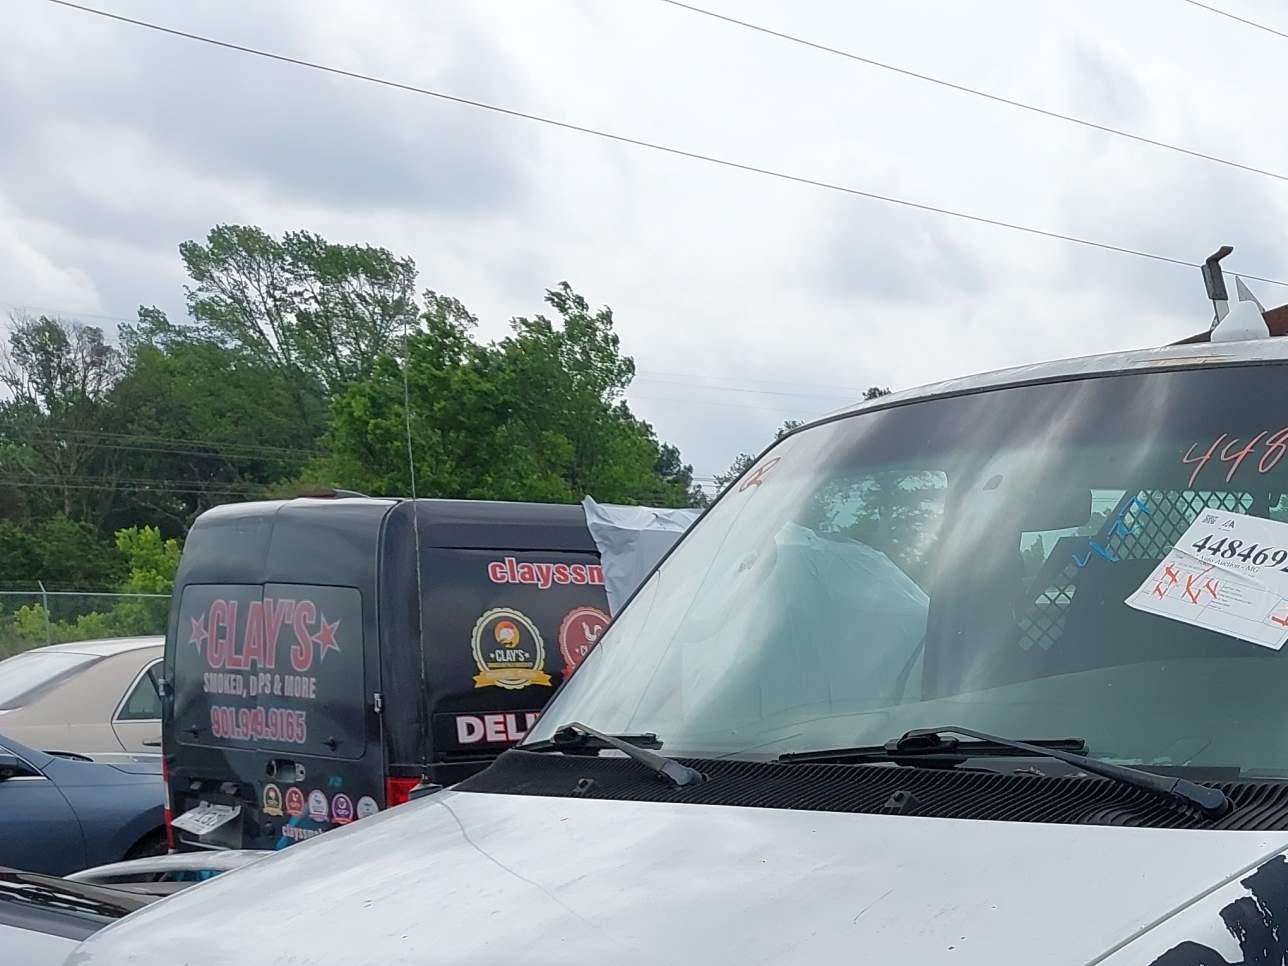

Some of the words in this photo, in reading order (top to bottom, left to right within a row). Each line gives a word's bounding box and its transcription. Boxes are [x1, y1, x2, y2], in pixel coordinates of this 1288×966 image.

[207, 598, 317, 672] CLAY'S
[495, 650, 526, 662] CLAY'S
[203, 672, 247, 697] SMOKED,
[273, 674, 282, 695] &
[284, 675, 317, 698] MORE
